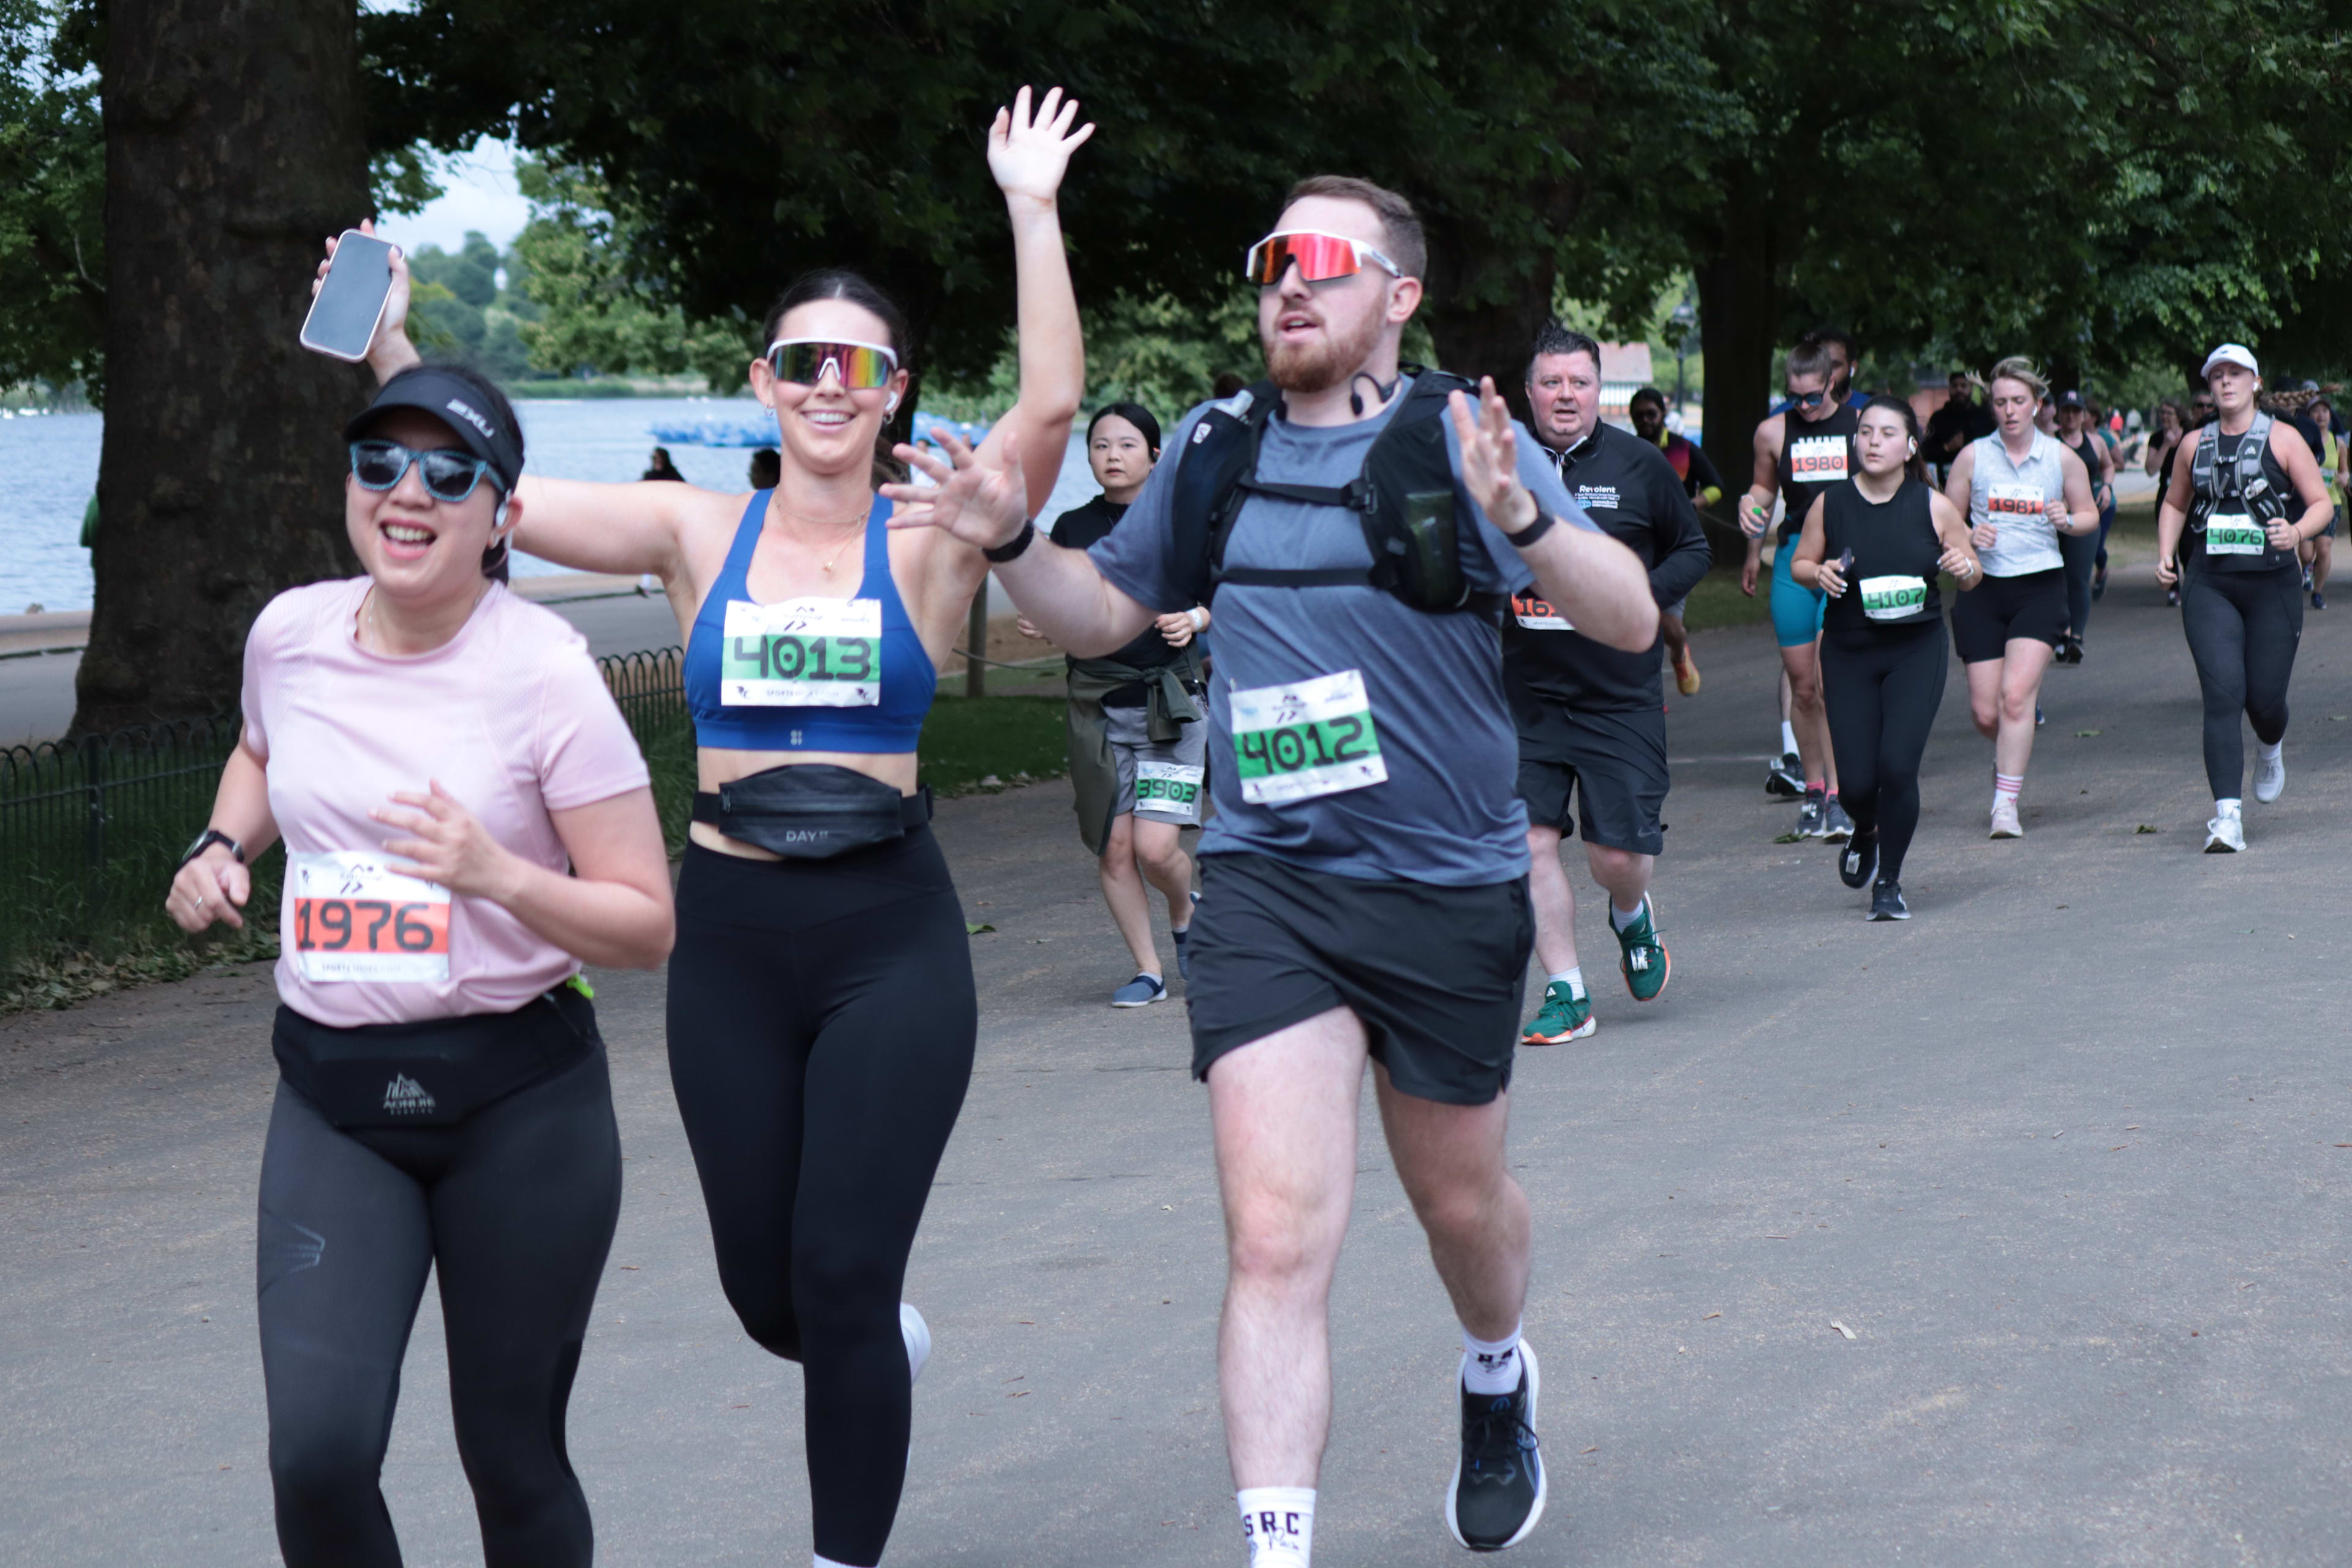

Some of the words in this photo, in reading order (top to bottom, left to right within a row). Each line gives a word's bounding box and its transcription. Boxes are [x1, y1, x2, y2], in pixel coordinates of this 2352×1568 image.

[1796, 456, 1844, 472] 1980
[1579, 484, 1616, 494] Revolent
[1994, 498, 2037, 514] 1981
[2210, 529, 2263, 545] 4076
[1518, 599, 1559, 617] 16
[1868, 588, 1924, 609] 4107
[734, 634, 871, 680] 4013
[1242, 716, 1370, 774] 4012
[1138, 779, 1197, 803] 3903
[299, 900, 434, 952] 1976
[1243, 1511, 1299, 1537] SRC
